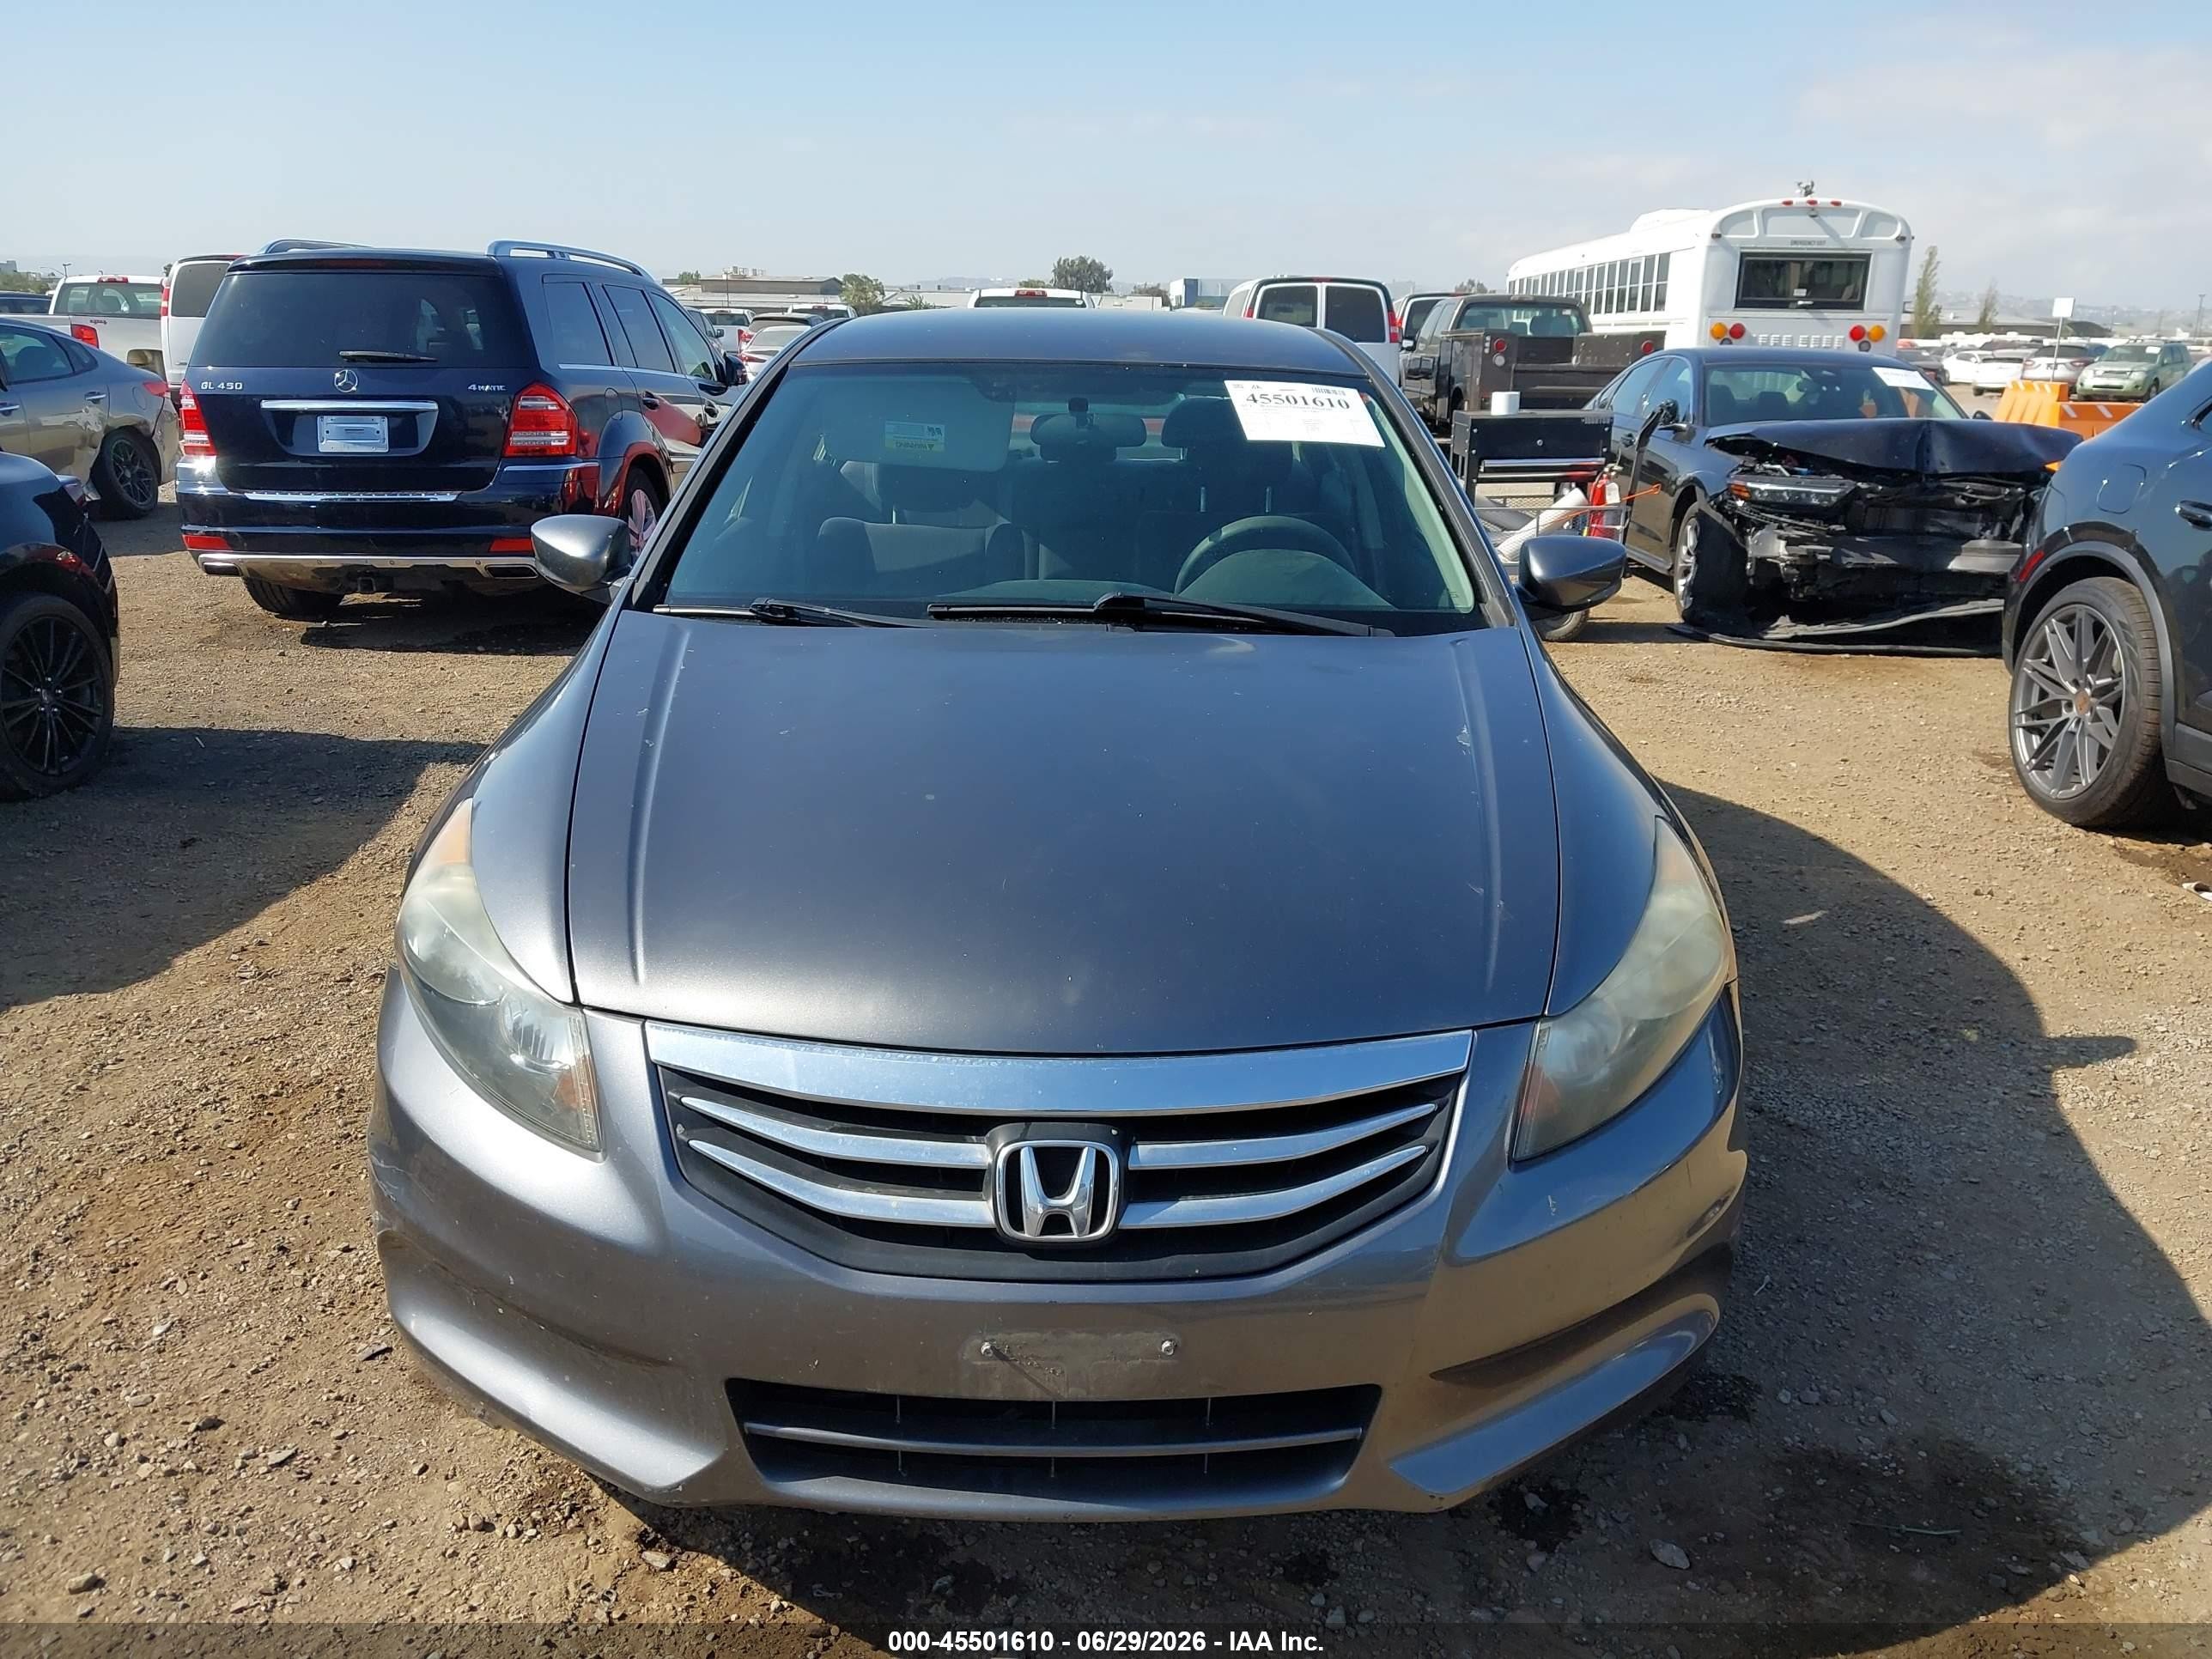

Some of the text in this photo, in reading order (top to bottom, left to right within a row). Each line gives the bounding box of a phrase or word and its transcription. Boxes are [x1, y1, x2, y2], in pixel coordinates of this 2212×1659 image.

[201, 381, 243, 390] GL 450
[467, 384, 507, 392] 4MATIC
[1245, 392, 1351, 410] 45501610
